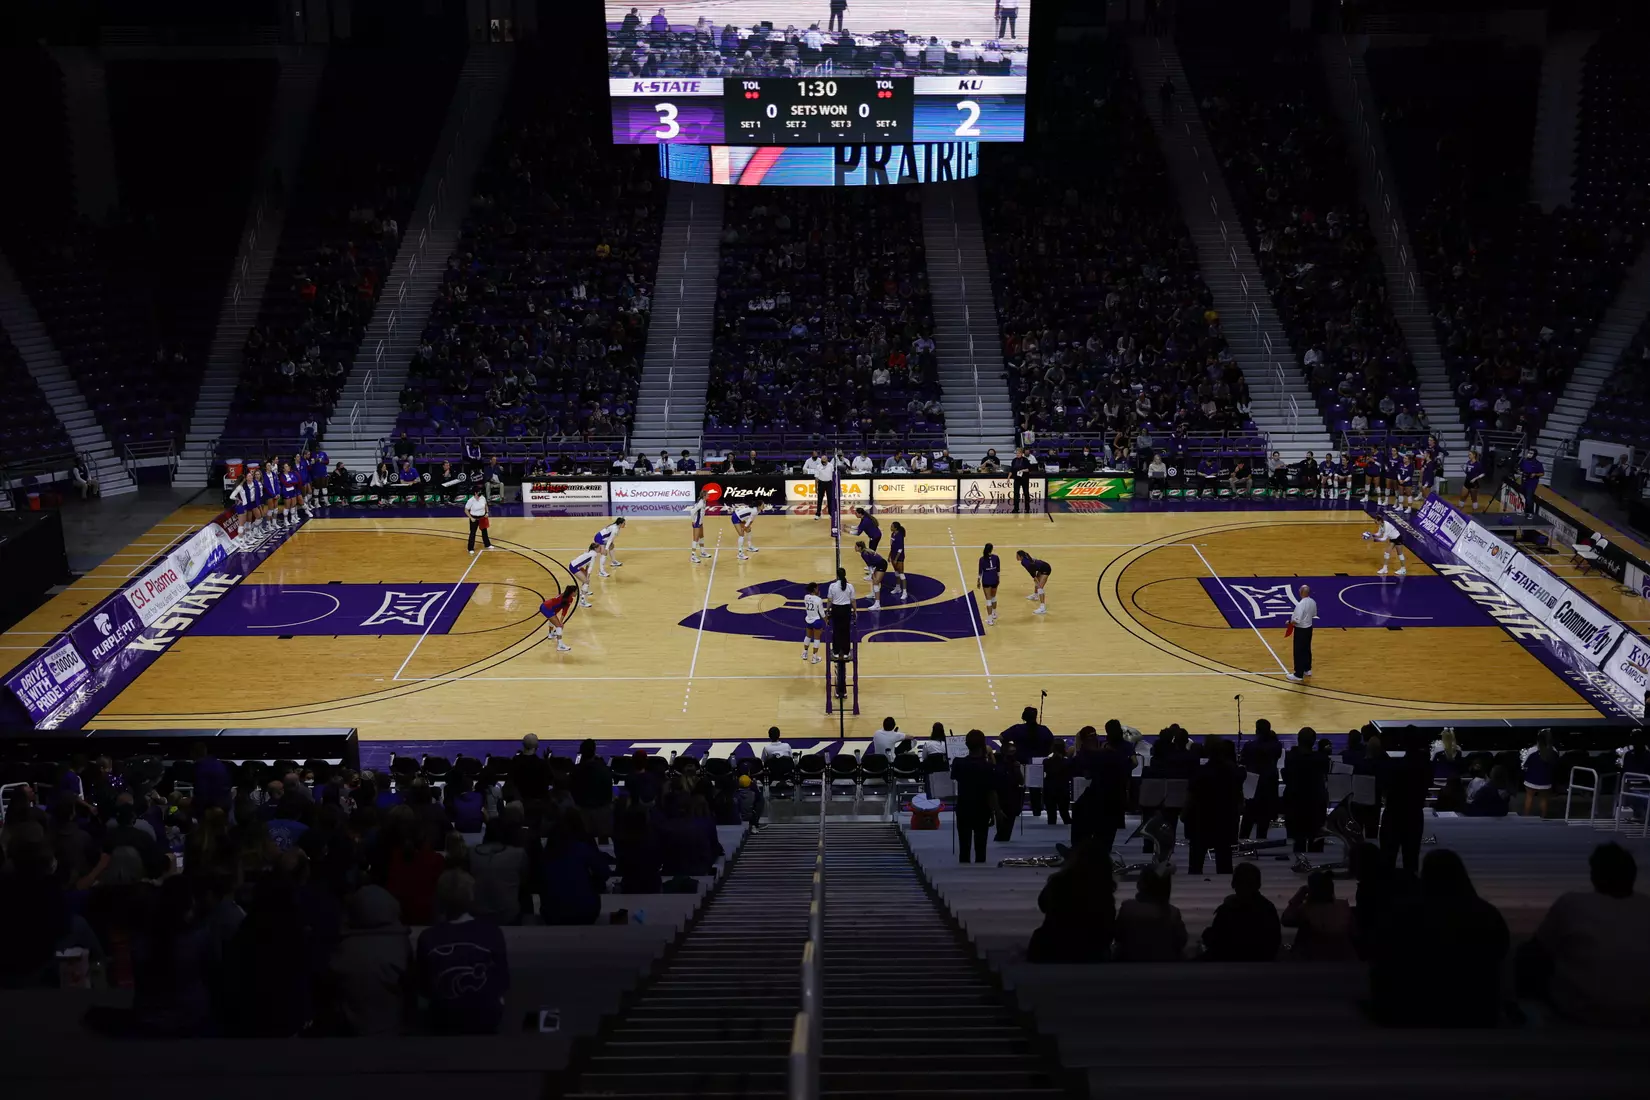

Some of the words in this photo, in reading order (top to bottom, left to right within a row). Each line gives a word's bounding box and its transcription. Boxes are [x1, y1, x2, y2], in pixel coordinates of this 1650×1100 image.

[633, 81, 701, 93] K-STATE
[742, 81, 760, 90] TOL
[797, 81, 838, 97] 1:30
[876, 80, 894, 90] TOL
[958, 80, 983, 91] KU
[766, 103, 778, 119] 0
[790, 105, 818, 116] SETS
[818, 105, 848, 116] WON
[858, 103, 870, 118] 0
[654, 102, 680, 139] 3
[740, 121, 755, 129] SET
[831, 120, 844, 128] SET
[845, 120, 852, 128] 3
[876, 120, 889, 128] SET
[890, 120, 897, 128] 4
[954, 100, 981, 137] 2
[835, 142, 979, 186] PRAIRIE
[630, 489, 670, 497] SMOOTHIE
[723, 486, 754, 498] Pizza
[753, 486, 777, 497] Hut
[877, 484, 905, 492] POINTE
[989, 491, 1005, 499] Via
[130, 588, 150, 610] CSL
[145, 568, 178, 600] Plasma
[806, 602, 815, 611] 22
[1431, 563, 1562, 641] K-STATE
[125, 572, 243, 652] K-STATE
[91, 627, 125, 660] PURPLE
[121, 618, 137, 637] PIT
[20, 662, 48, 691] DRIVE
[1620, 662, 1643, 684] CAMPUS
[27, 678, 53, 703] WITH
[35, 684, 65, 713] PRIDE!
